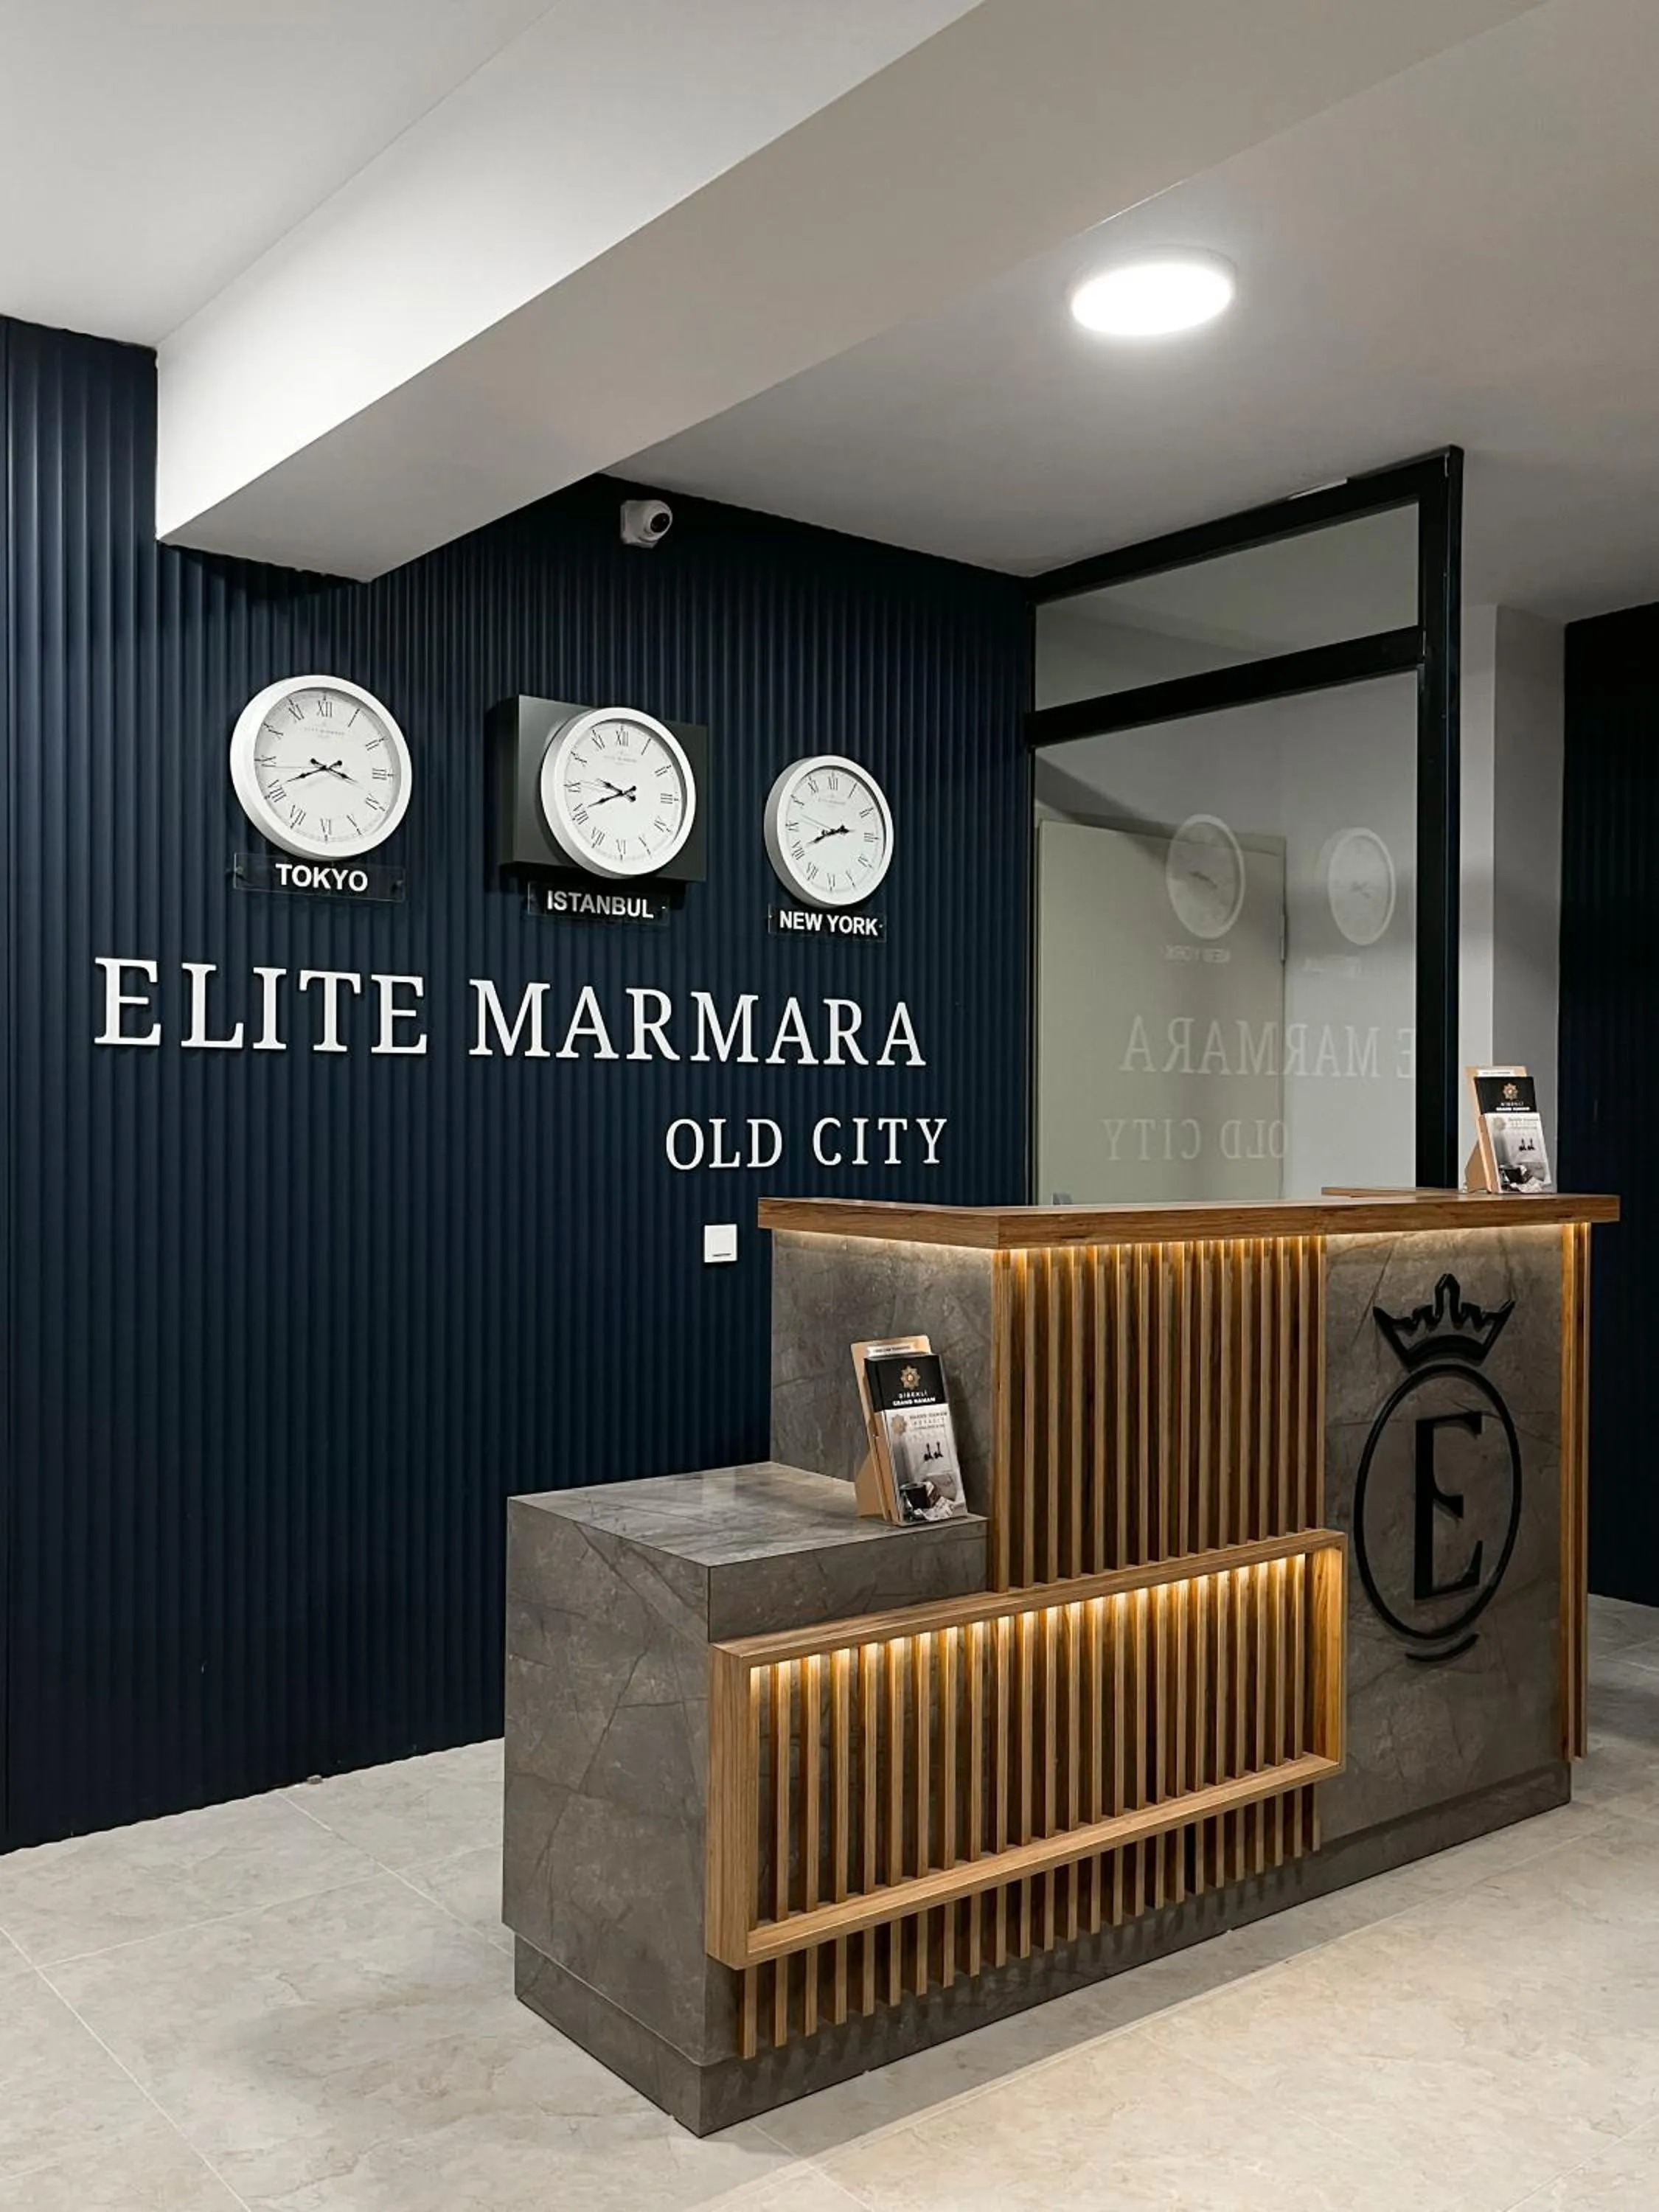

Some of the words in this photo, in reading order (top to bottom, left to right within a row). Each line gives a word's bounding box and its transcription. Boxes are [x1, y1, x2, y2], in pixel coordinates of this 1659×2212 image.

[316, 700, 333, 718] XII
[365, 740, 380, 751] II
[615, 730, 630, 748] XII
[372, 768, 387, 781] III
[267, 779, 287, 803] VIII
[660, 793, 673, 804] III
[319, 817, 332, 835] VI
[275, 863, 368, 892] TOKYO
[546, 890, 654, 919] ISTANBUL
[779, 911, 822, 931] NEW
[826, 914, 878, 936] YORK
[94, 957, 428, 1054] ELITE
[468, 978, 927, 1067] MARMARA
[665, 1118, 783, 1171] OLD
[812, 1116, 947, 1166] CITY
[1413, 1411, 1483, 1600] E
